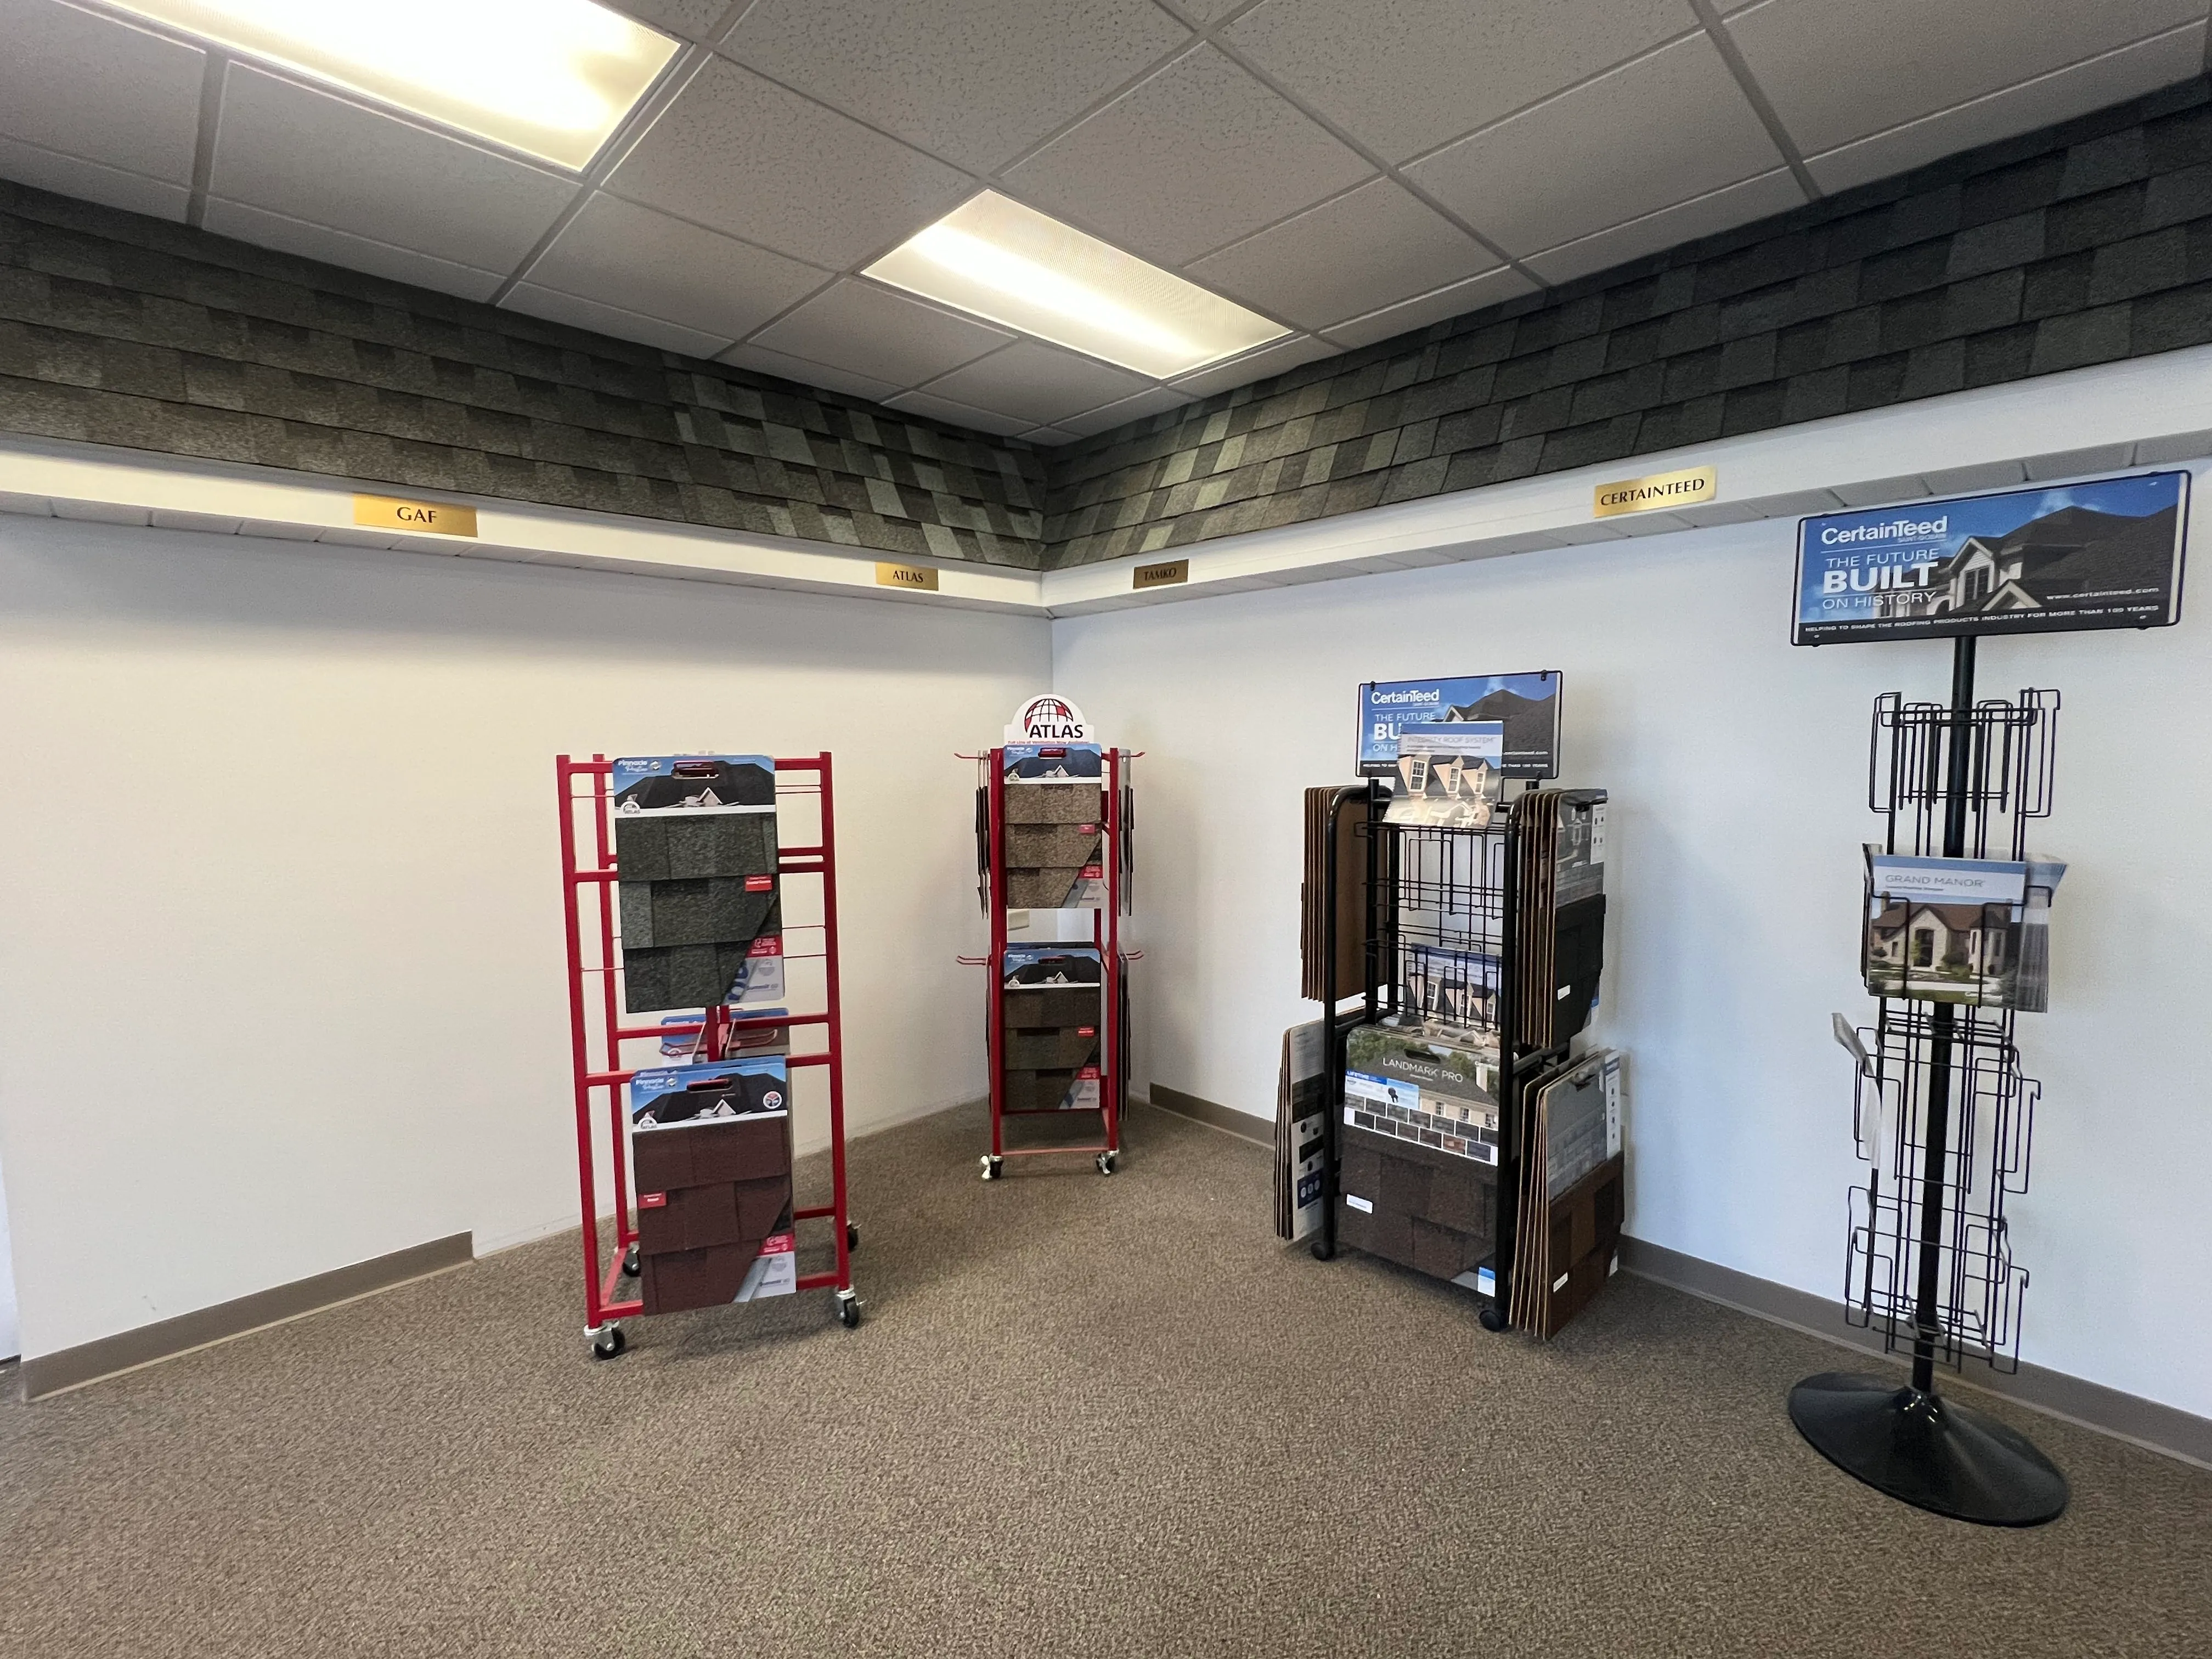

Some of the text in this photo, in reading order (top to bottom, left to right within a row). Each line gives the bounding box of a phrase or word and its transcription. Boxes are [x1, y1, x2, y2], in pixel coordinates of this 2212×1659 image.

[1600, 478, 1705, 506] CERTAINTEED
[397, 507, 437, 523] GAF
[1821, 515, 1948, 545] CertainTeed
[1825, 548, 1940, 568] THE FUTURE
[893, 570, 924, 583] ATLAS
[1144, 567, 1177, 581] TAMKO
[1823, 561, 1938, 594] BUILT
[1822, 591, 1937, 610] ON HISTORY
[1933, 616, 1979, 624] PRODUCTS
[1371, 689, 1440, 704] CertainTeed
[1375, 712, 1436, 722] THE FUTURE
[1029, 724, 1084, 738] ATLAS
[1373, 743, 1388, 752] ON
[1885, 874, 1984, 887] GRAND MANOR
[1382, 1057, 1438, 1076] LANDMARK
[1441, 1069, 1464, 1083] PRO
